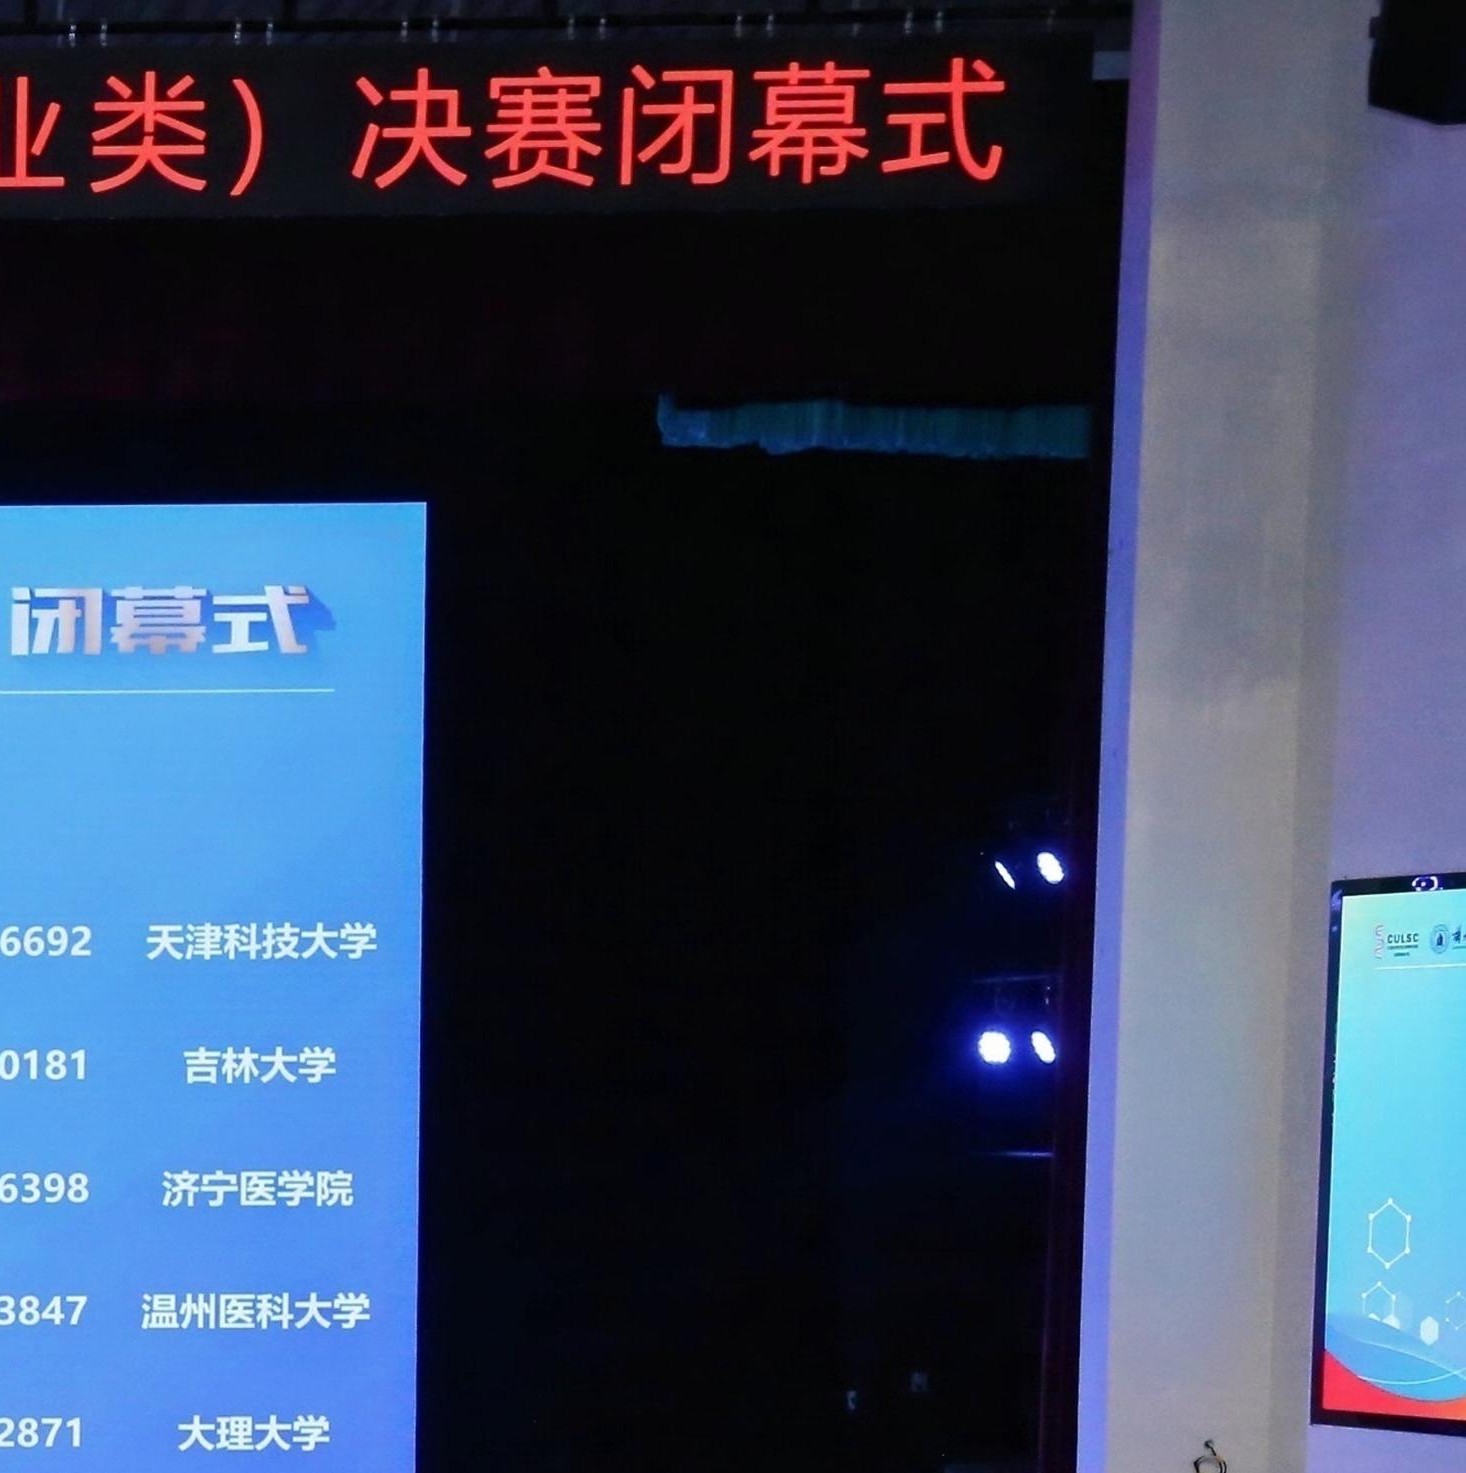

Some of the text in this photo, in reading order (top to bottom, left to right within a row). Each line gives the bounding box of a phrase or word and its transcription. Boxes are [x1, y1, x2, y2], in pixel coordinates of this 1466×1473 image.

[10, 584, 310, 657] 闭幕式
[147, 923, 376, 960] 天津科技大学
[1387, 933, 1420, 944] CULSC
[184, 1047, 335, 1083] 吉林大学
[163, 1170, 353, 1206] 济宁医学院
[142, 1293, 370, 1329] 温州医科大学
[179, 1415, 329, 1451] 大理大学
